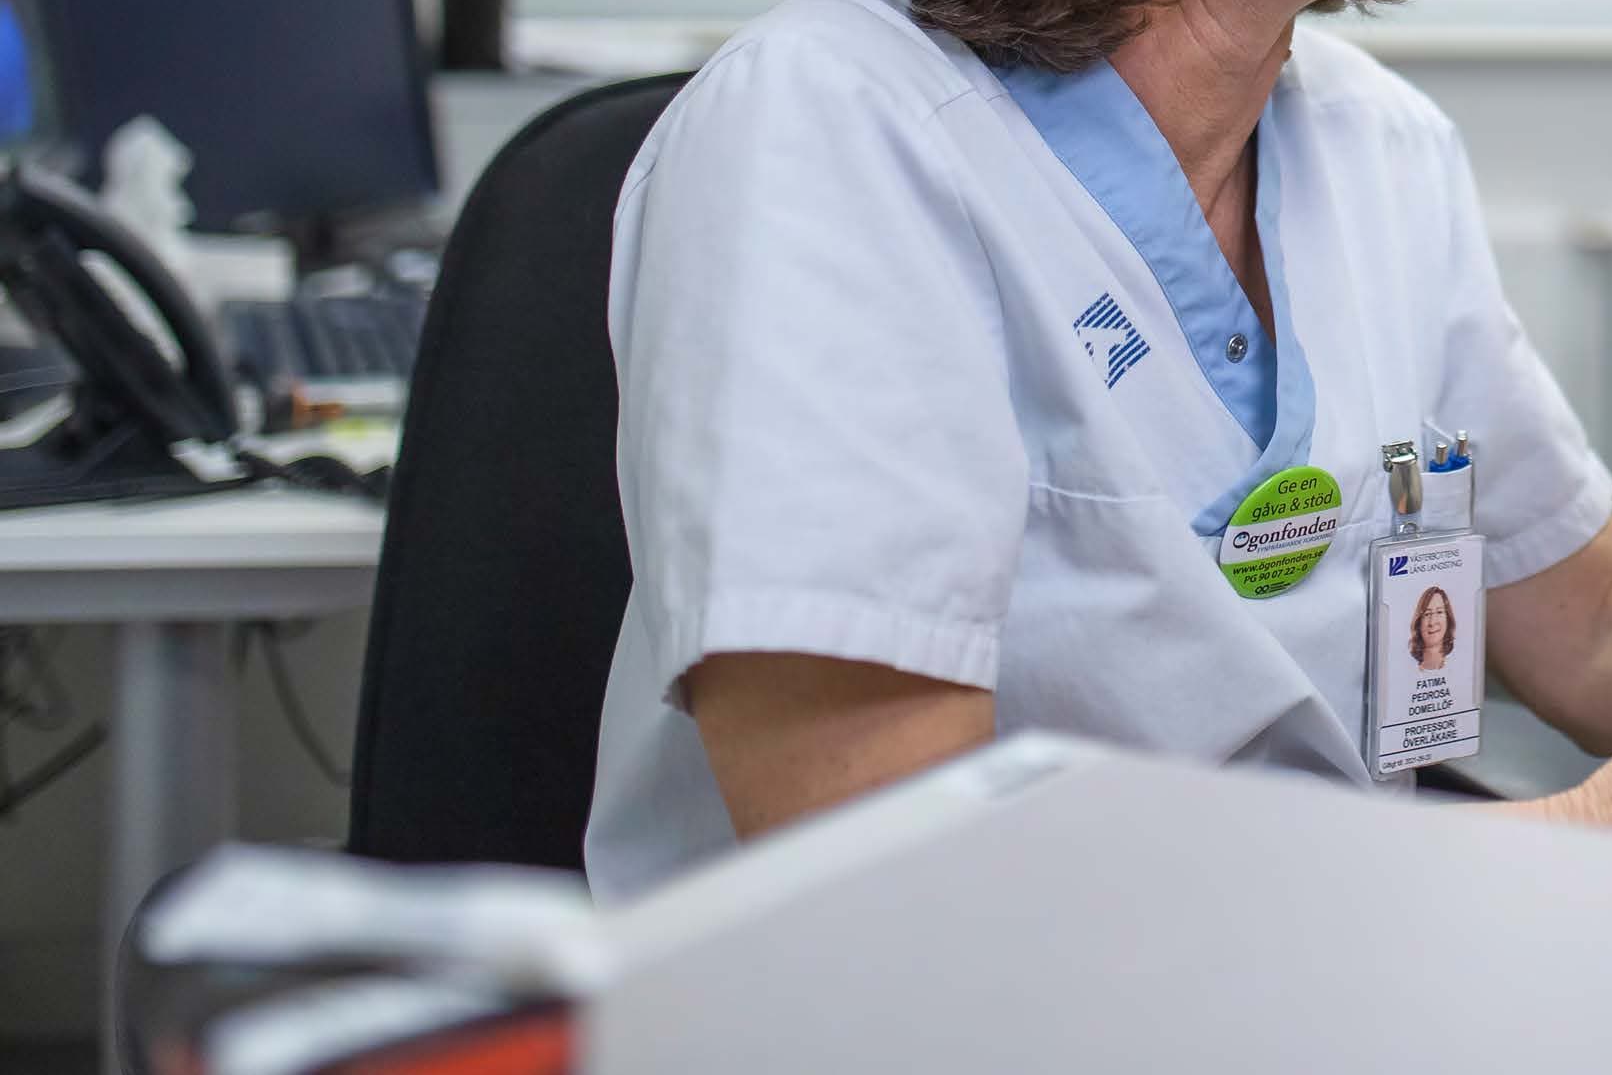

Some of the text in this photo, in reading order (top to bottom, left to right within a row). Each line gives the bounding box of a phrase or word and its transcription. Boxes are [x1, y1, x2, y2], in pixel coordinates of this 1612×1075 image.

[1278, 478, 1317, 494] Ge en
[1252, 489, 1333, 522] gåva & stöd
[1244, 574, 1257, 584] PG
[1259, 572, 1271, 581] 90
[1272, 570, 1283, 579] 07
[1284, 566, 1296, 576] 22
[1416, 677, 1446, 689] FATIMA
[1412, 688, 1451, 703] PEDROSA
[1409, 699, 1454, 716] DOMELLÖF
